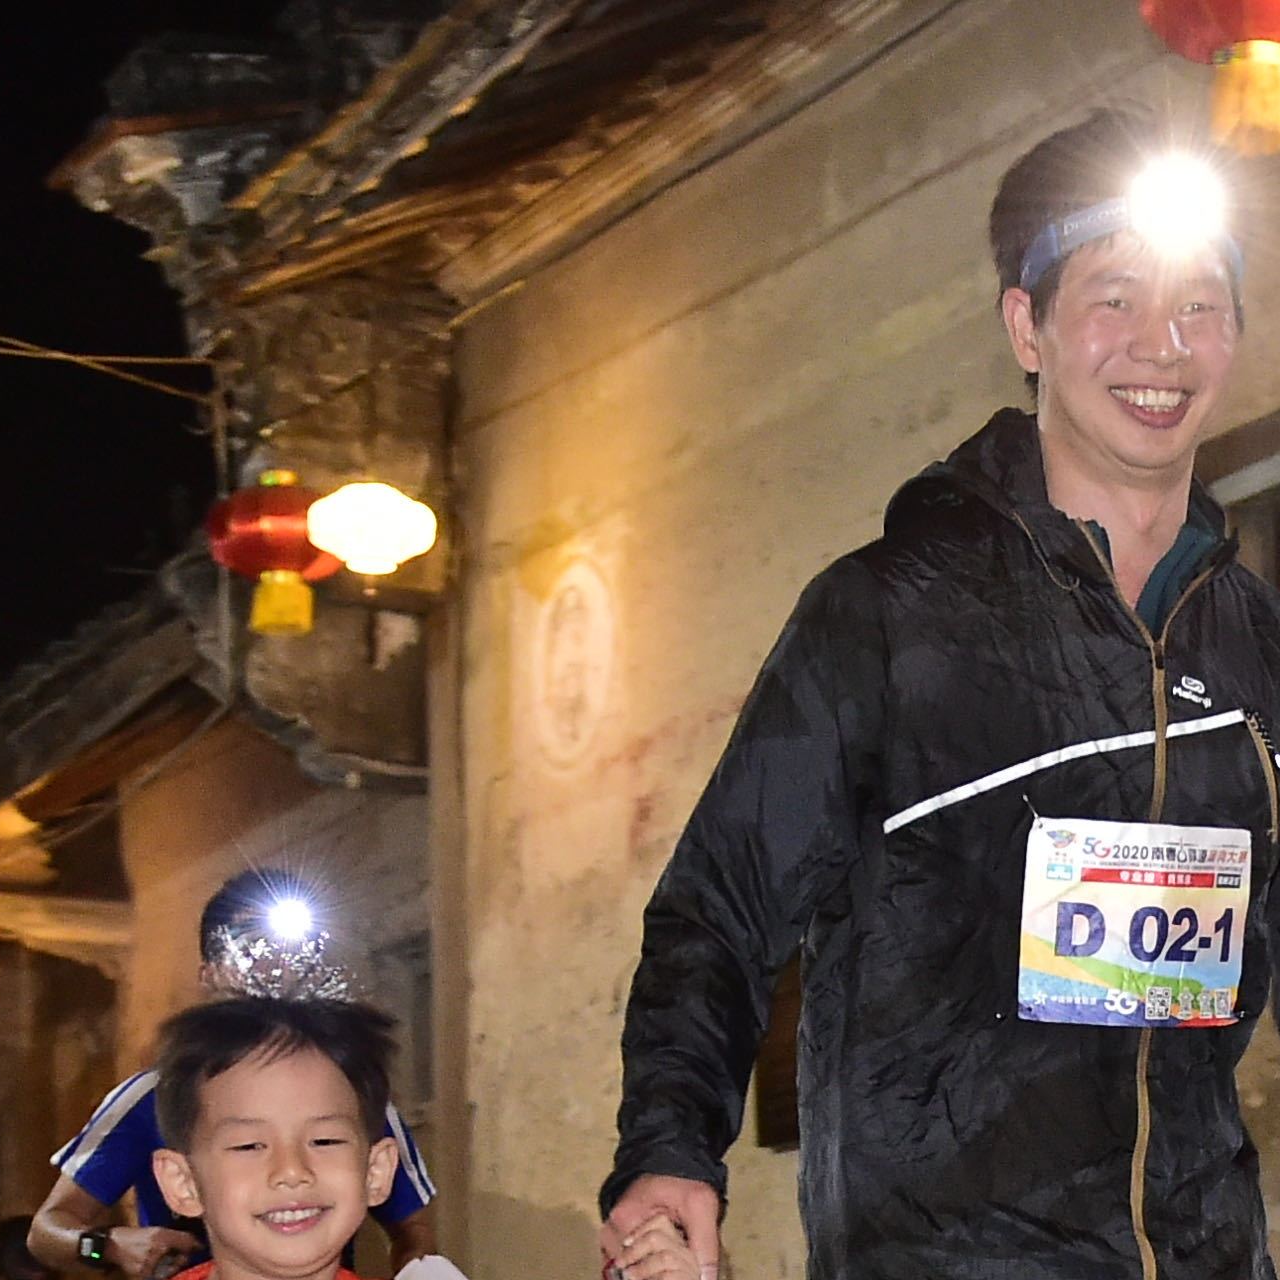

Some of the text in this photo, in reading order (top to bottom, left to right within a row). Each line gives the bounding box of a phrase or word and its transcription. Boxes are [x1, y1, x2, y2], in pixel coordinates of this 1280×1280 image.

[1082, 836, 1112, 859] 5G
[1112, 844, 1149, 860] 2020
[1054, 901, 1234, 963] D 02-1
[1103, 987, 1138, 1015] 5G
